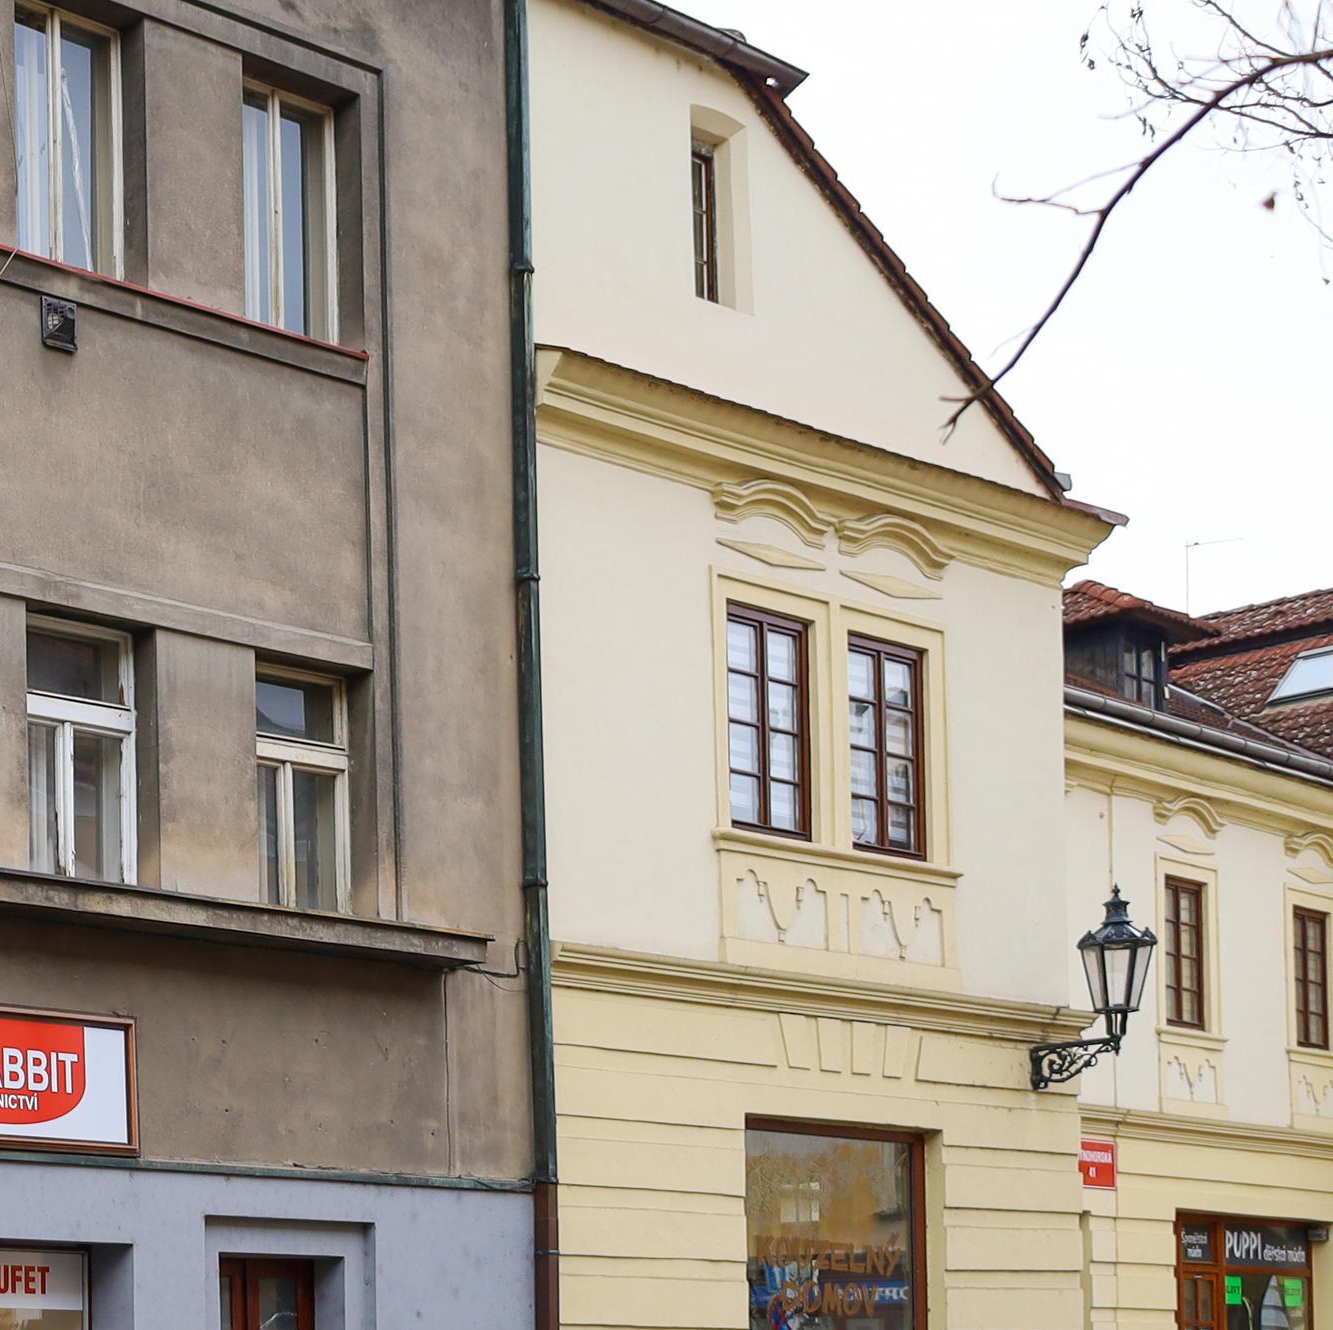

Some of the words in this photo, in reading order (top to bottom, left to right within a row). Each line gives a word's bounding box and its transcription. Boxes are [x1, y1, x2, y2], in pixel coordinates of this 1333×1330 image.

[755, 1232, 902, 1277] KOUZELNÝ
[1225, 1230, 1262, 1261] PUPPI
[780, 1280, 878, 1317] DOMOV
